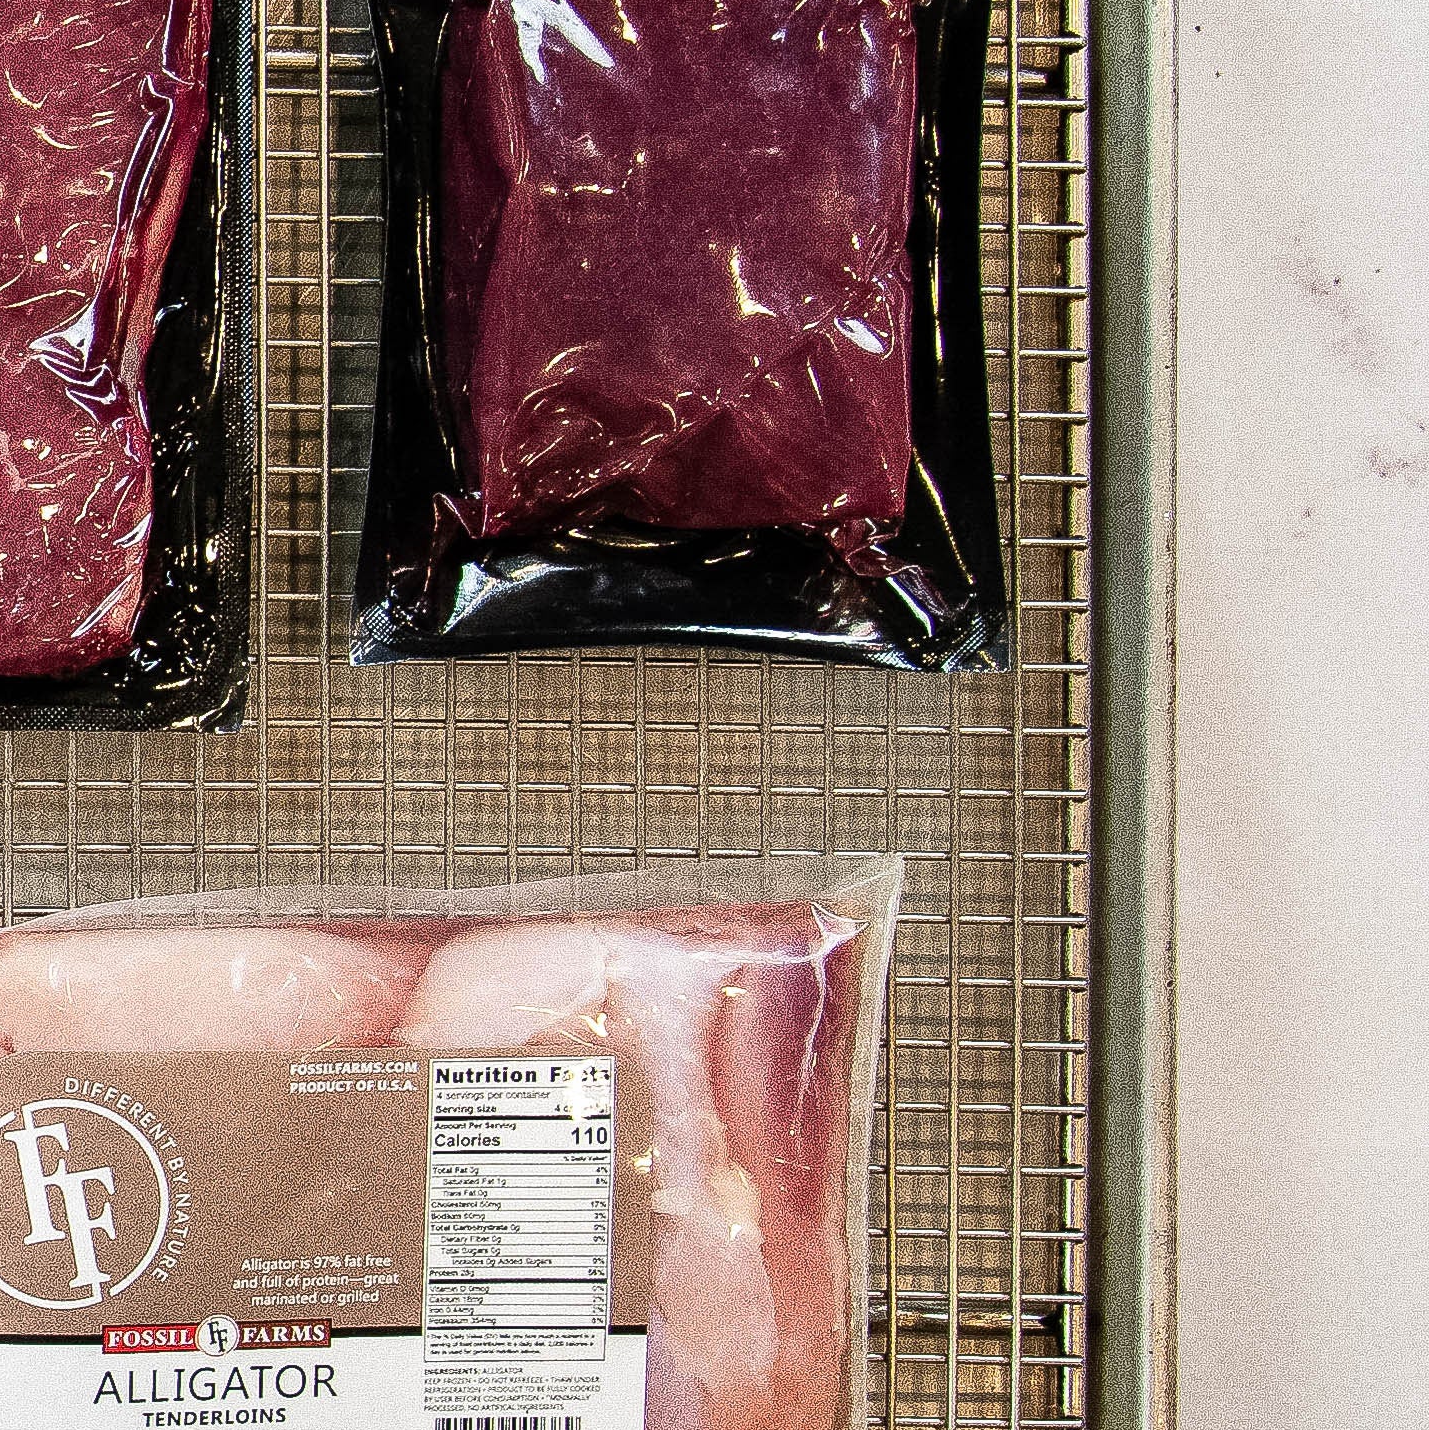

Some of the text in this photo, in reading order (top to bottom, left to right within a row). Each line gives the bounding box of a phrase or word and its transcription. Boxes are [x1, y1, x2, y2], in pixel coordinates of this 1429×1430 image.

[291, 1062, 418, 1075] FOSSILFARMS.COM
[436, 1067, 536, 1083] Nutrition
[291, 1080, 417, 1093] PRODUCT OF U.S.A.
[446, 1091, 484, 1100] servings
[487, 1092, 503, 1100] per
[506, 1091, 550, 1099] container
[436, 1105, 473, 1114] Serving
[477, 1105, 496, 1113] size
[435, 1127, 607, 1147] Calories 110
[64, 1077, 191, 1283] DIFFERENT BY NATURE
[453, 1224, 508, 1233] Carbohydrate
[241, 1255, 392, 1273] Alligator is 97% fat free
[232, 1276, 259, 1289] and
[261, 1275, 283, 1288] full
[286, 1274, 301, 1287] of
[251, 1290, 379, 1306] marinated or grilled
[107, 1328, 194, 1348] FOSSIL
[242, 1325, 325, 1344] FARMS
[93, 1364, 337, 1405] ALLIGATOR
[143, 1407, 286, 1428] TENDERLOINS
